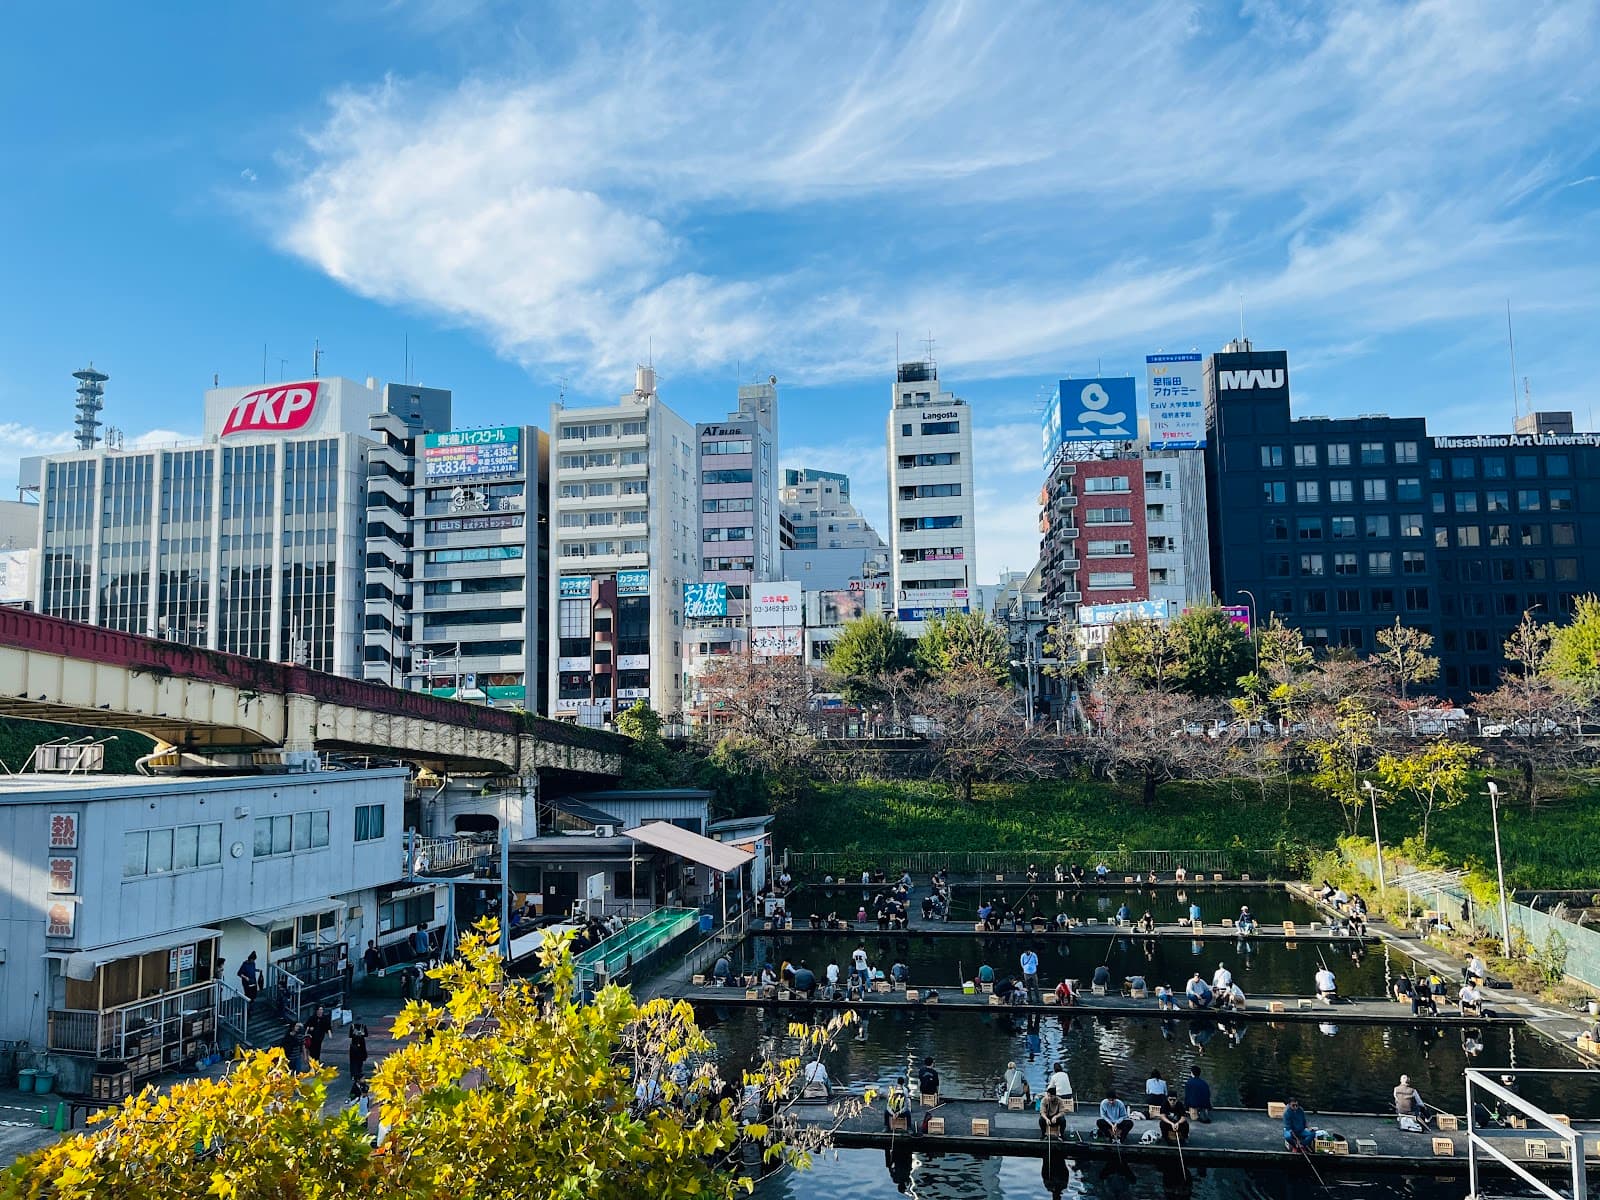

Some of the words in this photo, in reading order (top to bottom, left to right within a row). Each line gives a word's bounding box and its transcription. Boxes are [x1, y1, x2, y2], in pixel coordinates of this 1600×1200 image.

[1153, 377, 1181, 386] 早稲田
[1220, 369, 1284, 390] MAU
[1153, 387, 1197, 397] アカデミー
[232, 389, 313, 428] TKP
[922, 411, 958, 421] Langosta
[702, 427, 720, 436] AT
[438, 430, 506, 446] 東進ハイスクール
[1434, 436, 1508, 449] Musashino
[1509, 434, 1533, 446] Art
[1533, 432, 1600, 448] University
[438, 521, 462, 531] IELTS
[619, 574, 648, 583] カラオケ
[562, 580, 589, 590] カラオケ
